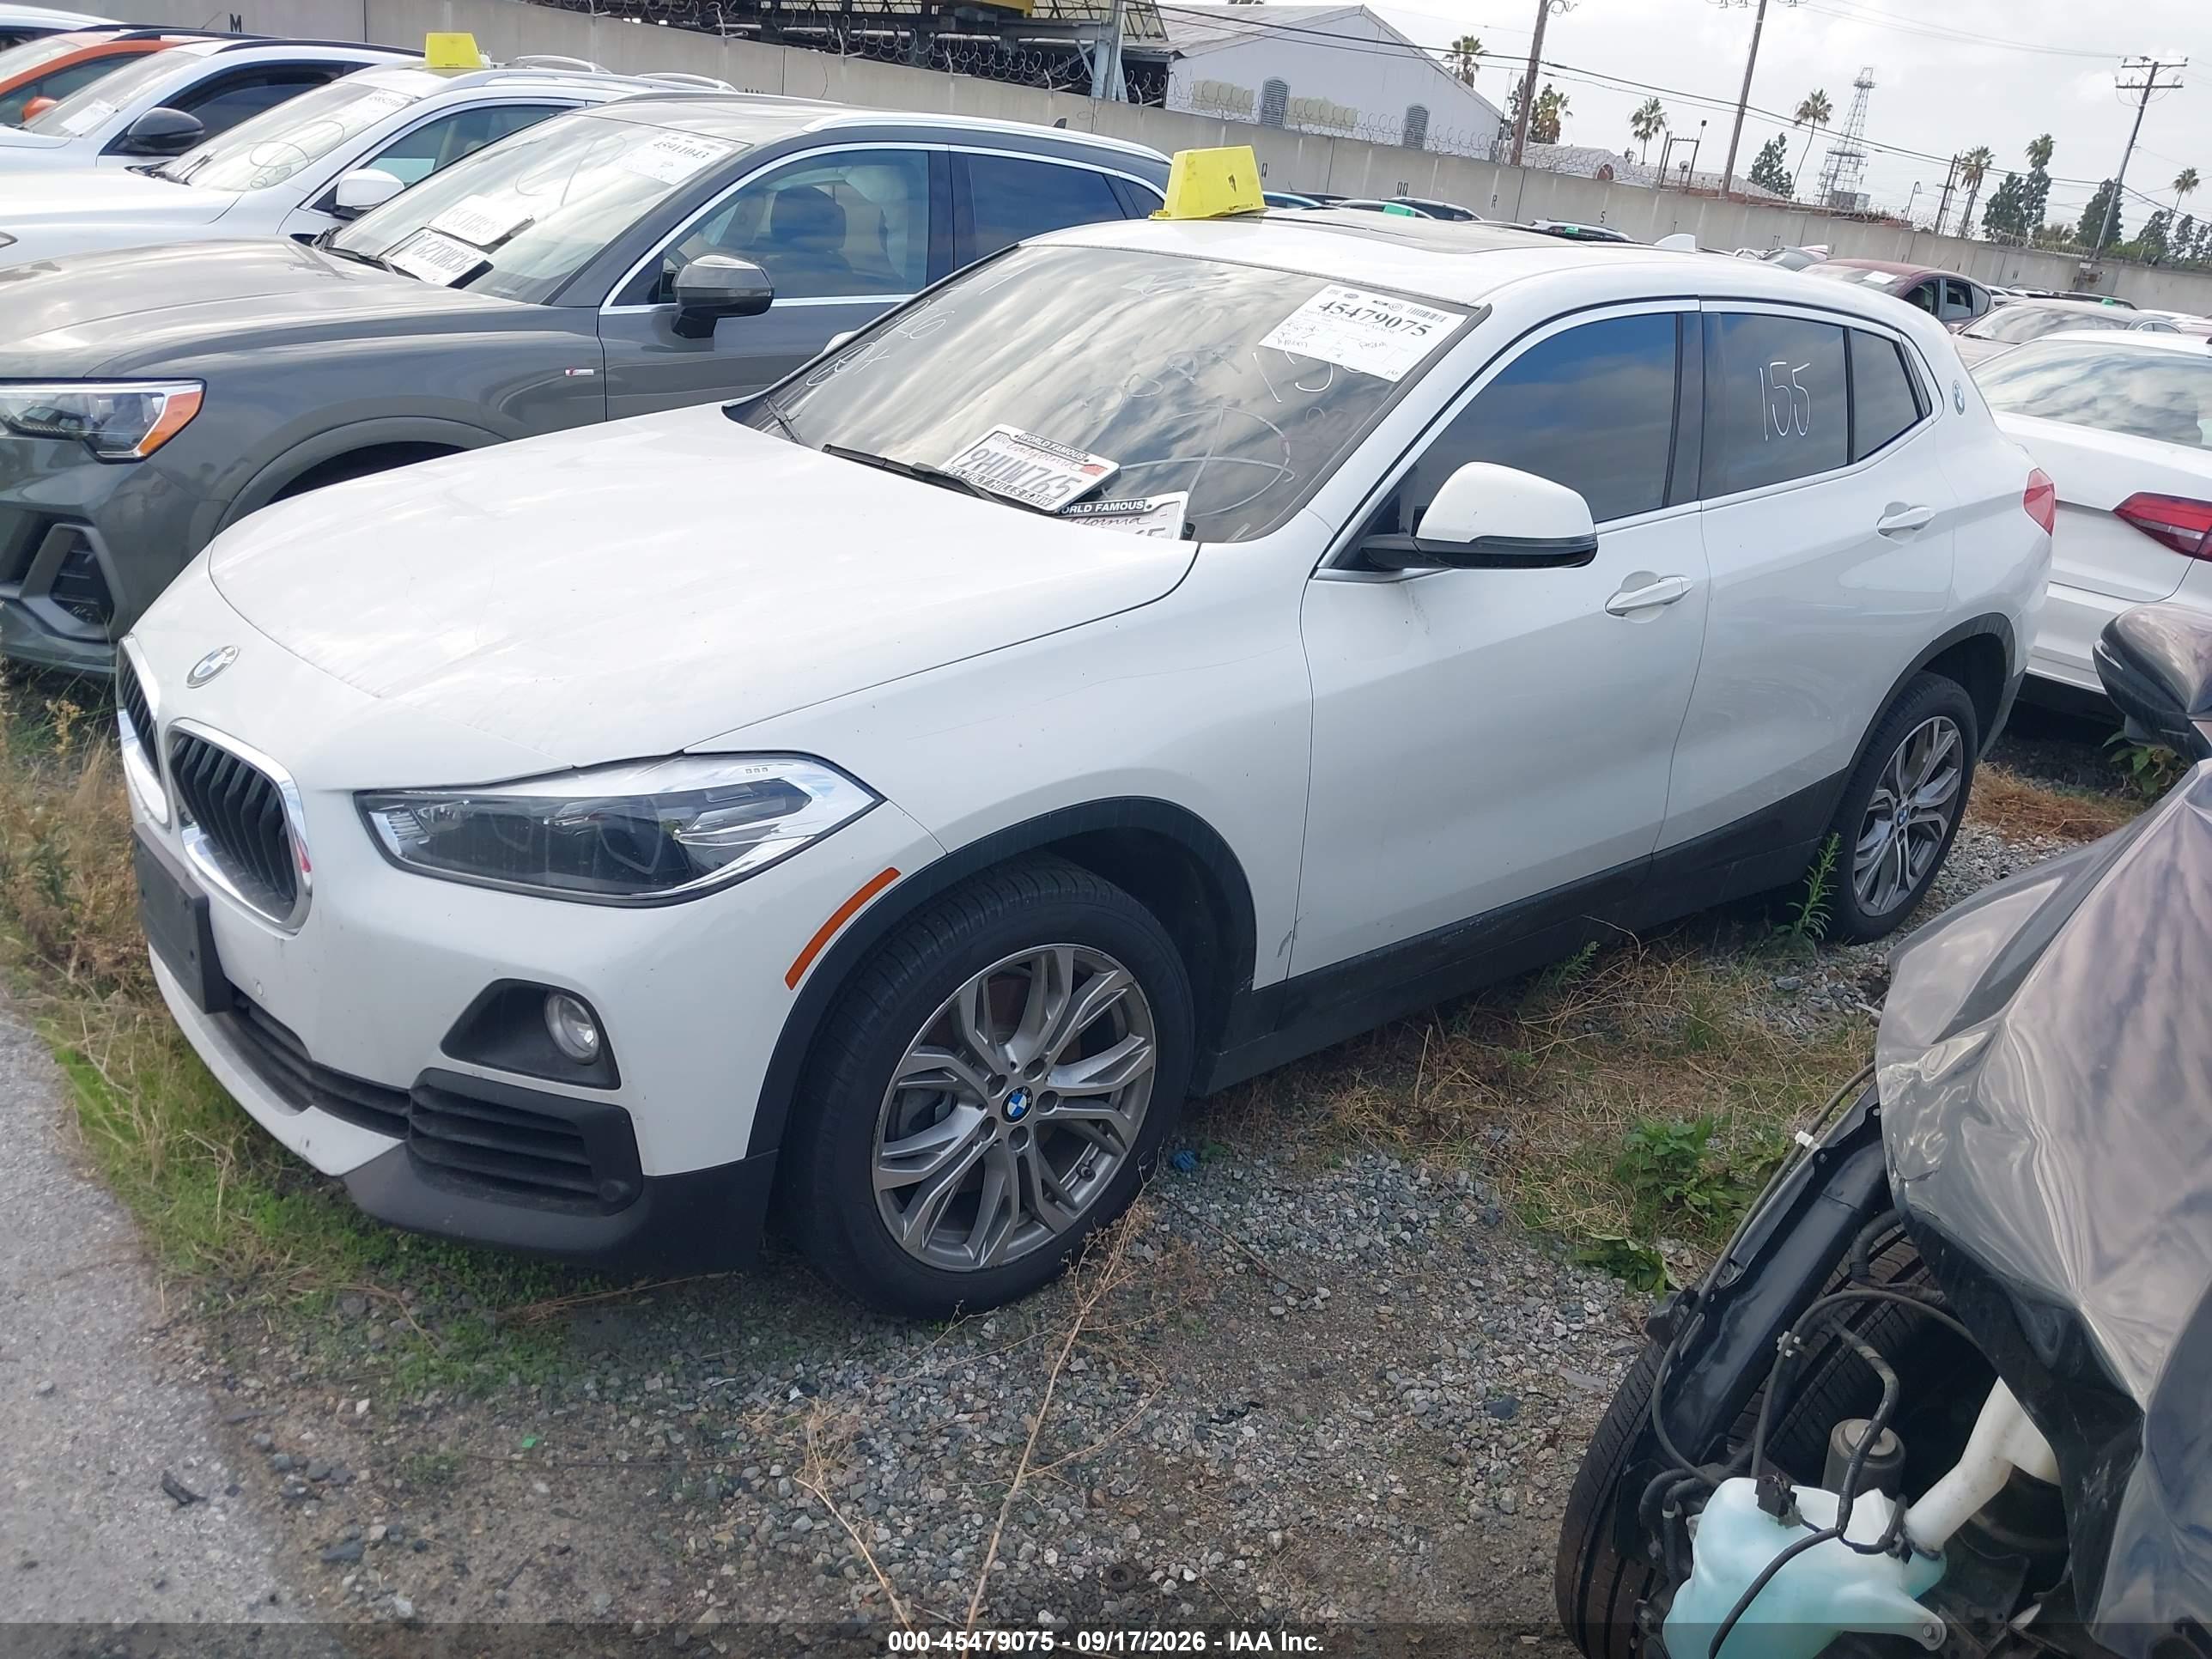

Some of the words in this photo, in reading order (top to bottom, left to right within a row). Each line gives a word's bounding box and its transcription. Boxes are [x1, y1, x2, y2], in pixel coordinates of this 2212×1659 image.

[229, 13, 242, 33] M
[1491, 194, 1498, 210] R
[1600, 210, 1607, 223] S
[1318, 300, 1432, 336] 45479075
[1759, 361, 1812, 441] 155
[1006, 442, 1079, 471] California
[1020, 433, 1049, 447] WORLD
[1049, 443, 1086, 460] FAMOUS
[945, 465, 990, 485] BEVERLY
[988, 481, 1023, 496] HILLS
[1021, 490, 1056, 507] BMW
[1060, 504, 1092, 514] ORLD
[1095, 501, 1145, 513] FAMOUS
